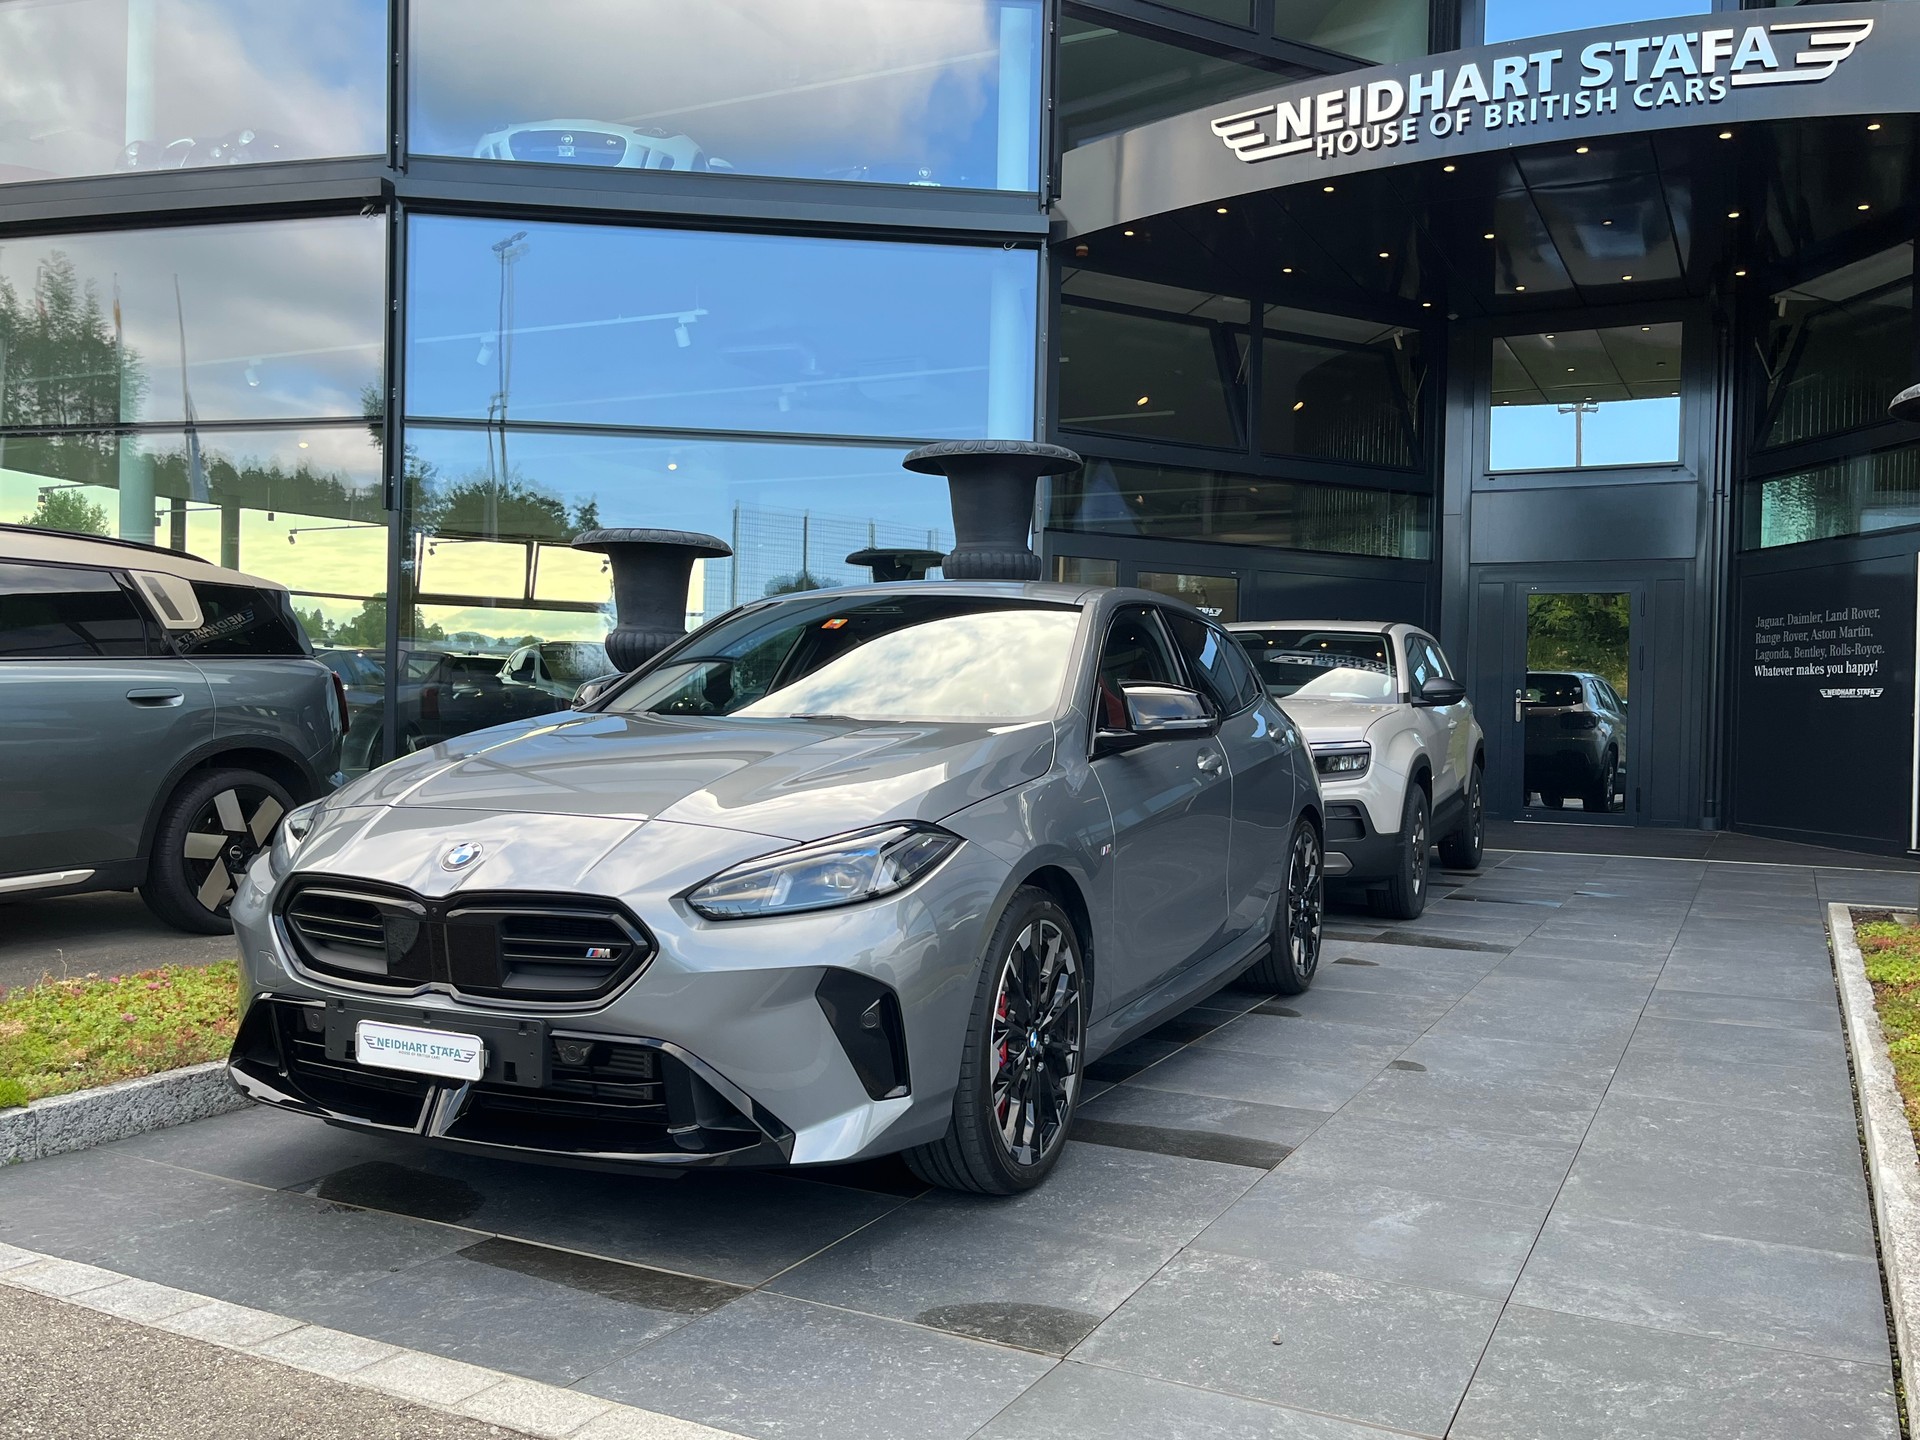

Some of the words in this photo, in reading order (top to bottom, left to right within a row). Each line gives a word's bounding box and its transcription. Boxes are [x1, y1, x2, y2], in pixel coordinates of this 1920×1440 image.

[1274, 49, 1563, 142] NEIDHART
[1579, 26, 1778, 88] STÄFA
[1316, 117, 1418, 158] HOUSE
[1430, 109, 1470, 139] OF
[1484, 87, 1617, 129] BRITISH
[1633, 77, 1728, 108] CARS
[1755, 616, 1785, 630] Jaguar,
[1787, 611, 1823, 626] Daimler,
[1825, 608, 1849, 622] Land
[1851, 607, 1881, 620] Rover,
[1755, 632, 1781, 646] Range
[1783, 630, 1809, 643] Rover,
[1811, 628, 1836, 641] Aston
[1839, 625, 1873, 639] Martin,
[1755, 647, 1792, 662] Lagonda,
[1794, 645, 1827, 660] Bentley,
[1829, 642, 1885, 658] Rolls-Royce.
[1754, 664, 1794, 677] Whatever
[1796, 662, 1825, 676] makes
[1826, 665, 1844, 677] you
[1845, 659, 1879, 676] happy!
[376, 1037, 428, 1053] NEIDHART
[430, 1045, 462, 1058] STÄFA
